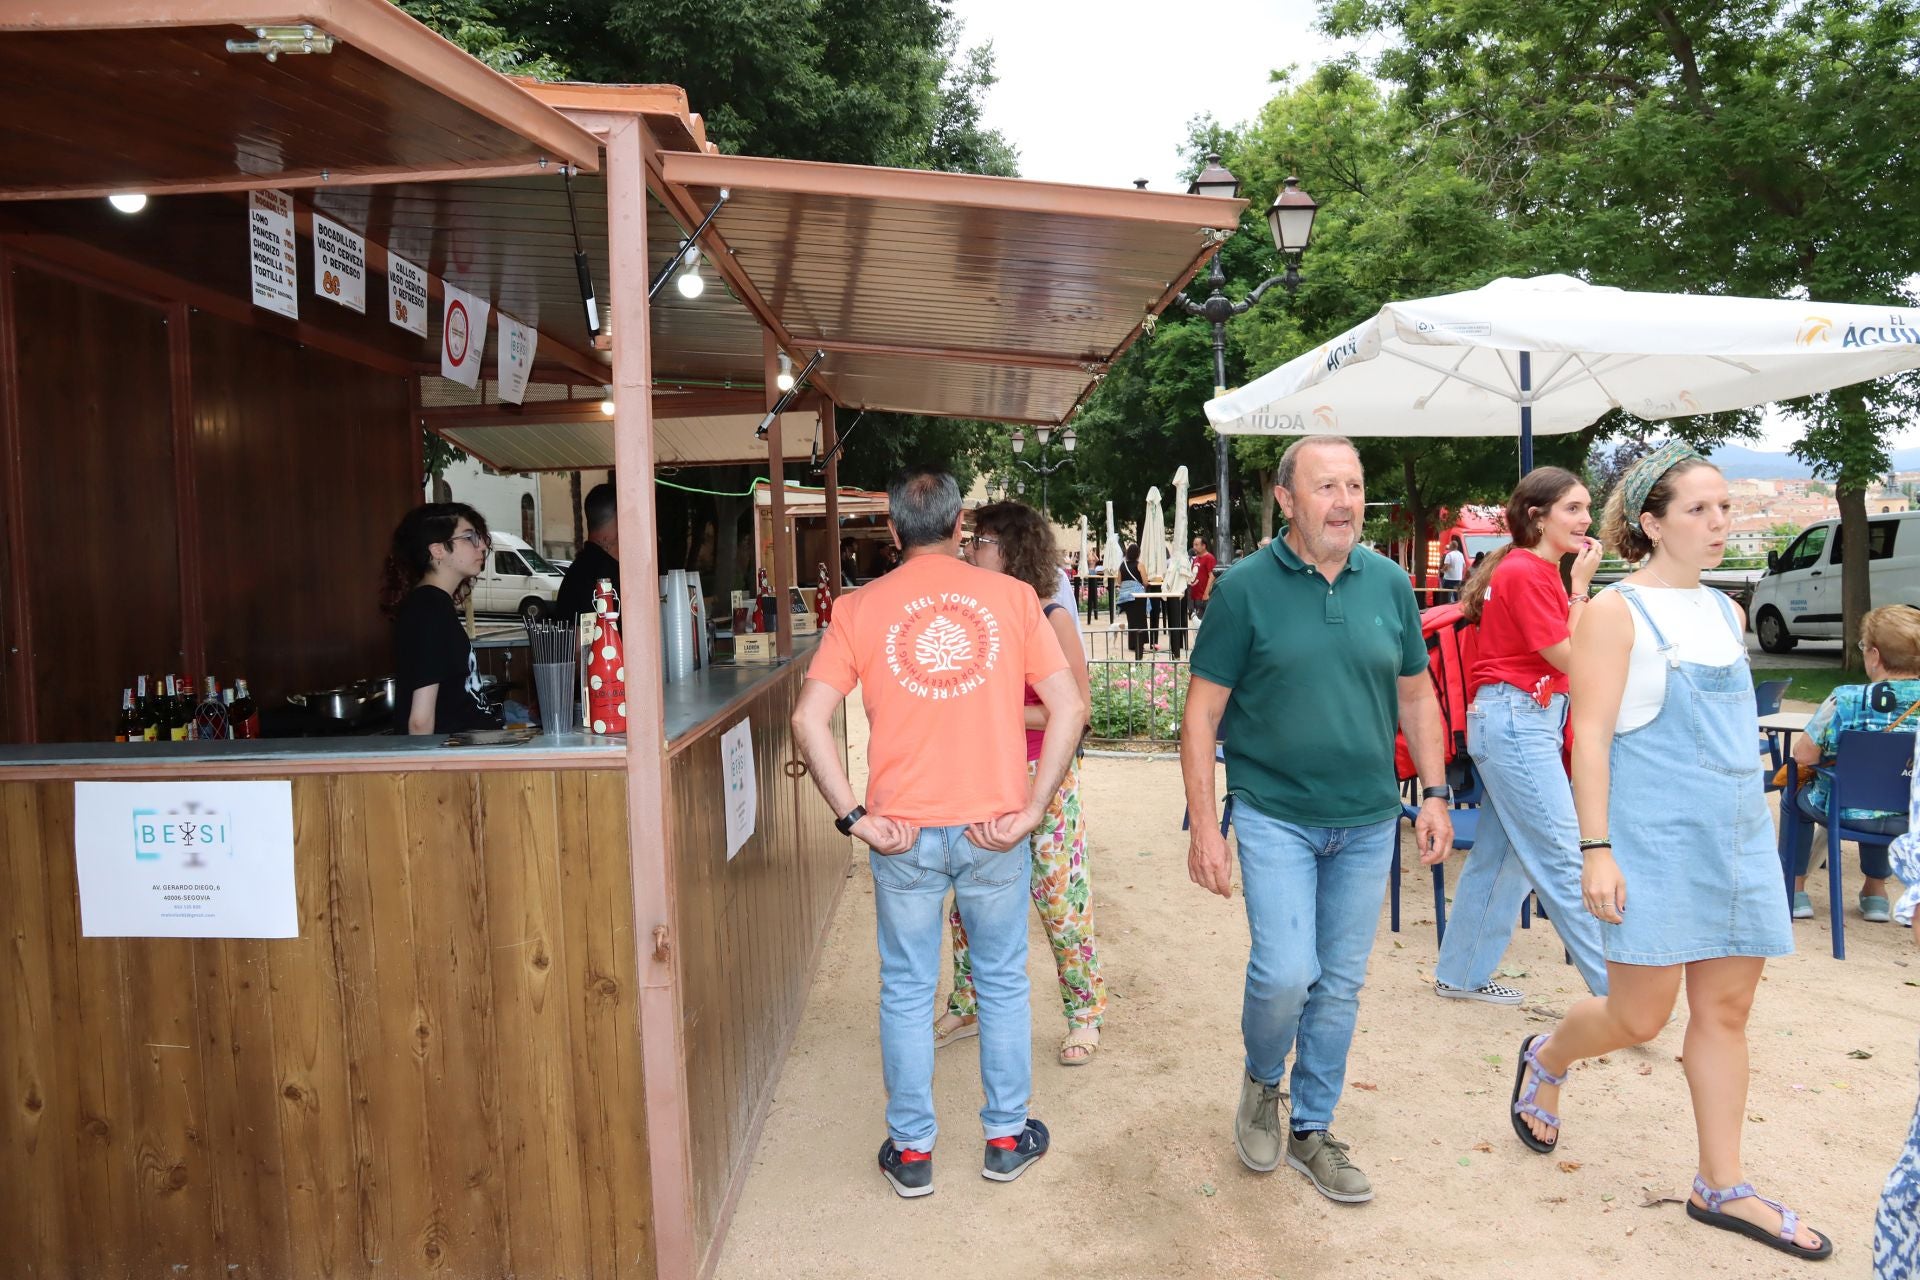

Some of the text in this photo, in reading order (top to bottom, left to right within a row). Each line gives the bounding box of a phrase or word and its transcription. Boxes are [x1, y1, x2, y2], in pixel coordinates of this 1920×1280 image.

[252, 210, 268, 226] LOMO
[252, 224, 280, 244] PANCETA
[318, 223, 357, 251] BOCADILLOS
[253, 238, 280, 257] CHORIZO
[317, 236, 336, 254] VASO
[337, 247, 363, 268] CERVEZA
[253, 251, 283, 271] MORCILLA
[322, 254, 361, 279] O REFRESCO
[395, 262, 416, 280] CALLOS
[254, 264, 283, 285] TORTILLA
[389, 270, 427, 298] VASO CERVEZA
[399, 287, 425, 309] REFRESCO
[1890, 314, 1906, 325] EL
[904, 595, 935, 615] FEEL
[940, 593, 978, 609] YOUR
[941, 604, 959, 612] AM
[900, 612, 922, 638] HAVE
[961, 608, 988, 659] GRATEFUL
[899, 650, 958, 688] EVERYTHING
[961, 661, 981, 681] FOR
[899, 676, 928, 698] NOT
